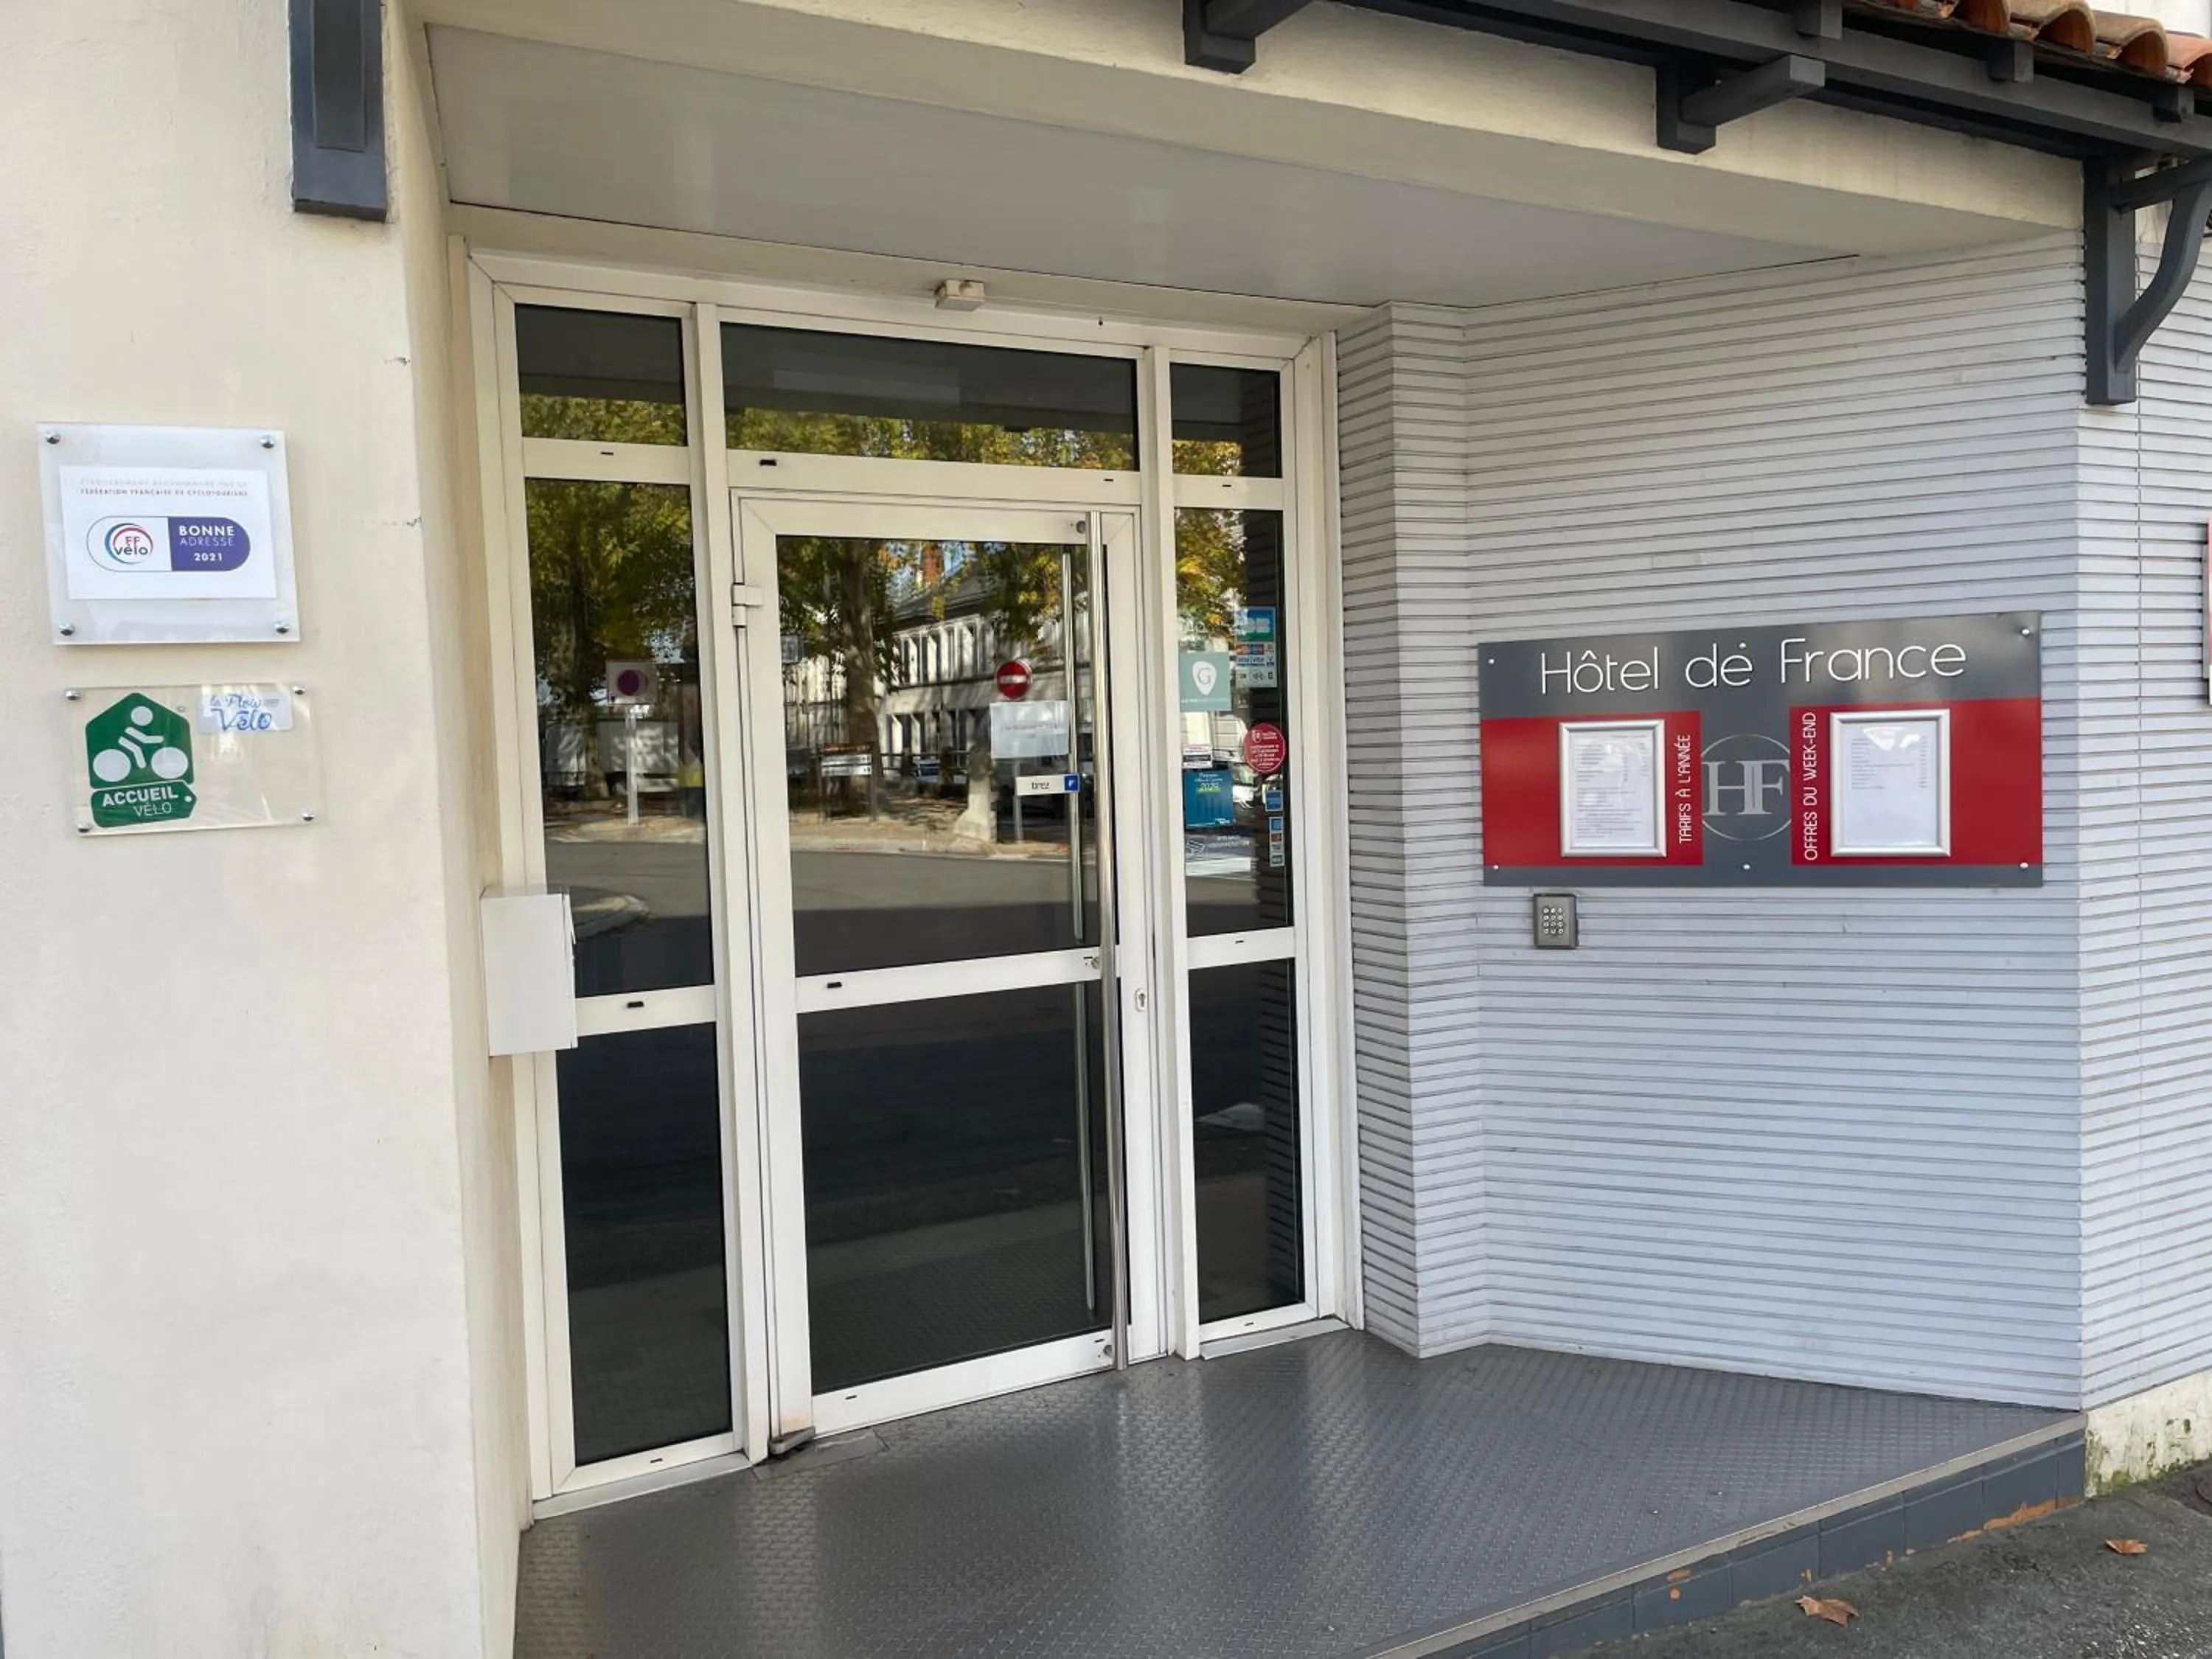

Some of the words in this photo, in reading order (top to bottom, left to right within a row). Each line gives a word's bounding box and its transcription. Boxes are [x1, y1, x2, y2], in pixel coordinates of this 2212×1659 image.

[125, 536, 140, 545] FF
[179, 526, 235, 537] BONNE
[180, 537, 234, 546] ADRESSE
[194, 552, 223, 561] 2021
[1541, 646, 1659, 695] Hôtel
[1685, 642, 1753, 688] de
[1781, 638, 1966, 684] France
[1802, 712, 1818, 782] WEEK-END
[1673, 734, 1691, 784] L'ANNÉE
[102, 785, 179, 807] ACCUEIL
[1674, 787, 1691, 798] À
[1701, 759, 1791, 816] HF
[1803, 787, 1818, 806] DU
[133, 801, 172, 818] VÉLO
[1678, 803, 1692, 844] TARIFS
[1804, 810, 1818, 861] OFFRES
